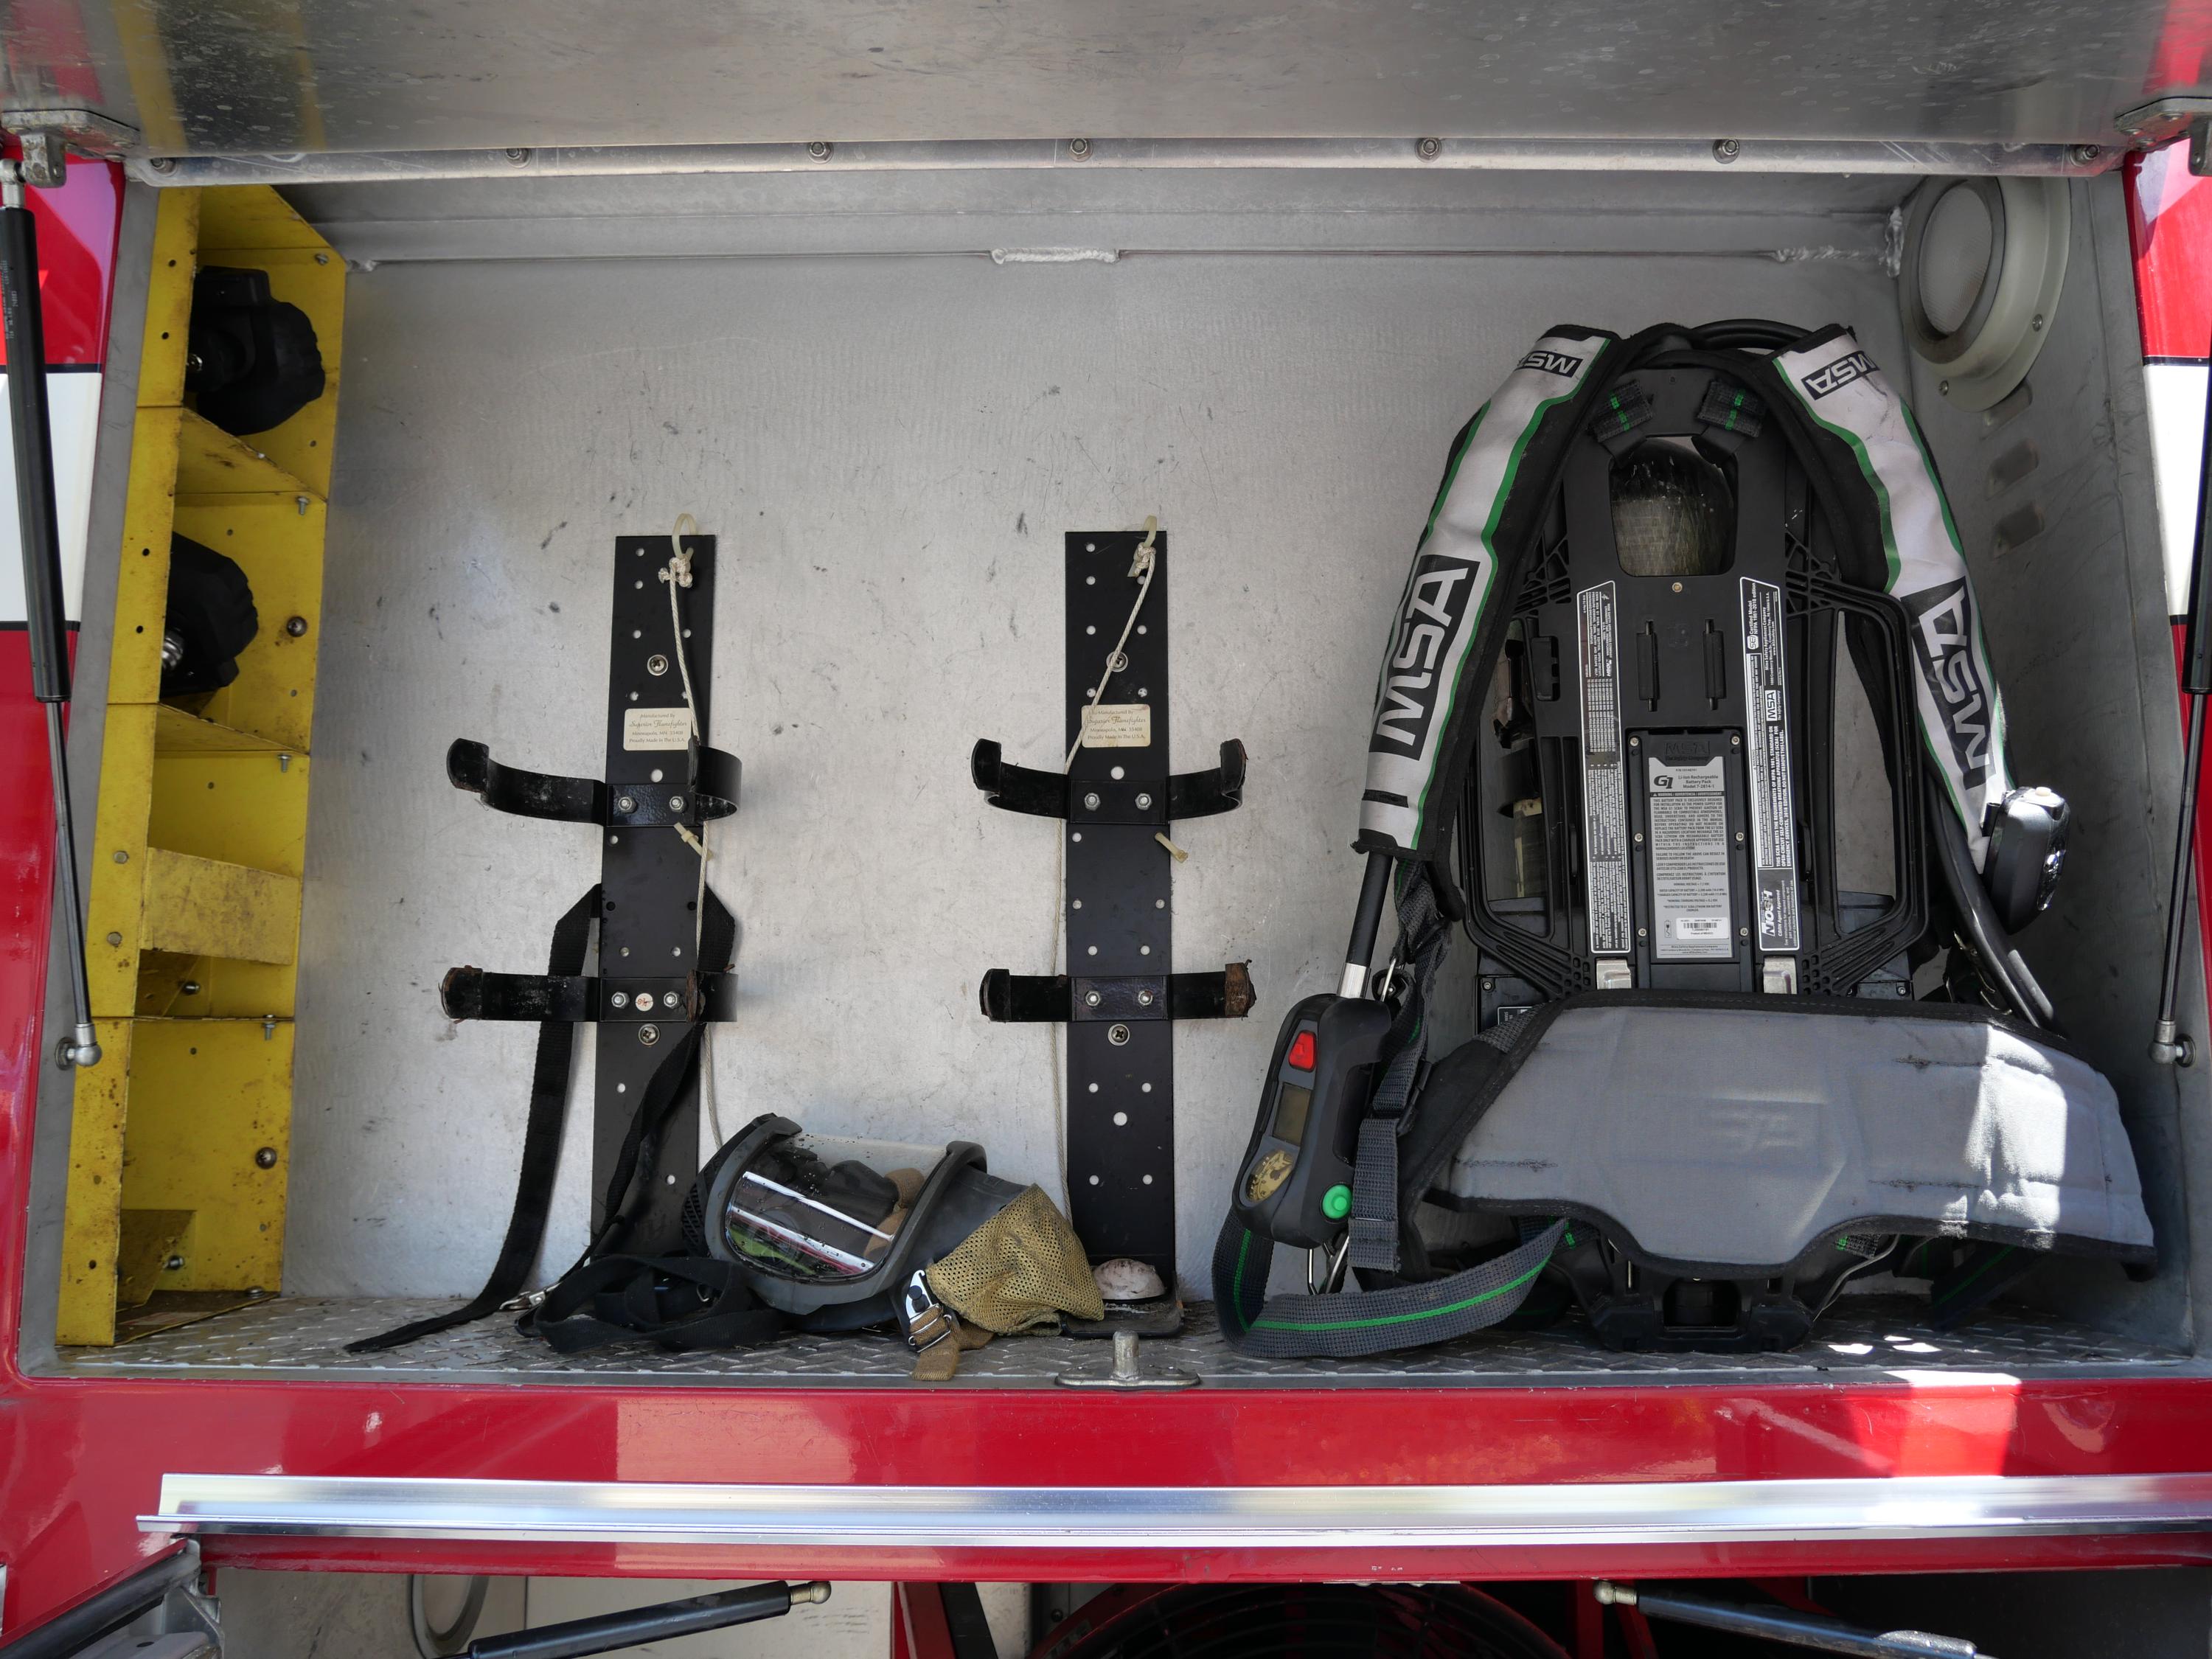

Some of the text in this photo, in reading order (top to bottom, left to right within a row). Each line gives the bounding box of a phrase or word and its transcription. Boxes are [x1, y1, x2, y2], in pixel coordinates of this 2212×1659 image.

[1806, 352, 1877, 395] MSA
[1376, 566, 1470, 747] MSA
[1918, 585, 1991, 770] MSA
[1767, 692, 1775, 719] MSA
[1654, 775, 1673, 789] G1
[1761, 890, 1775, 936] NIOSH
